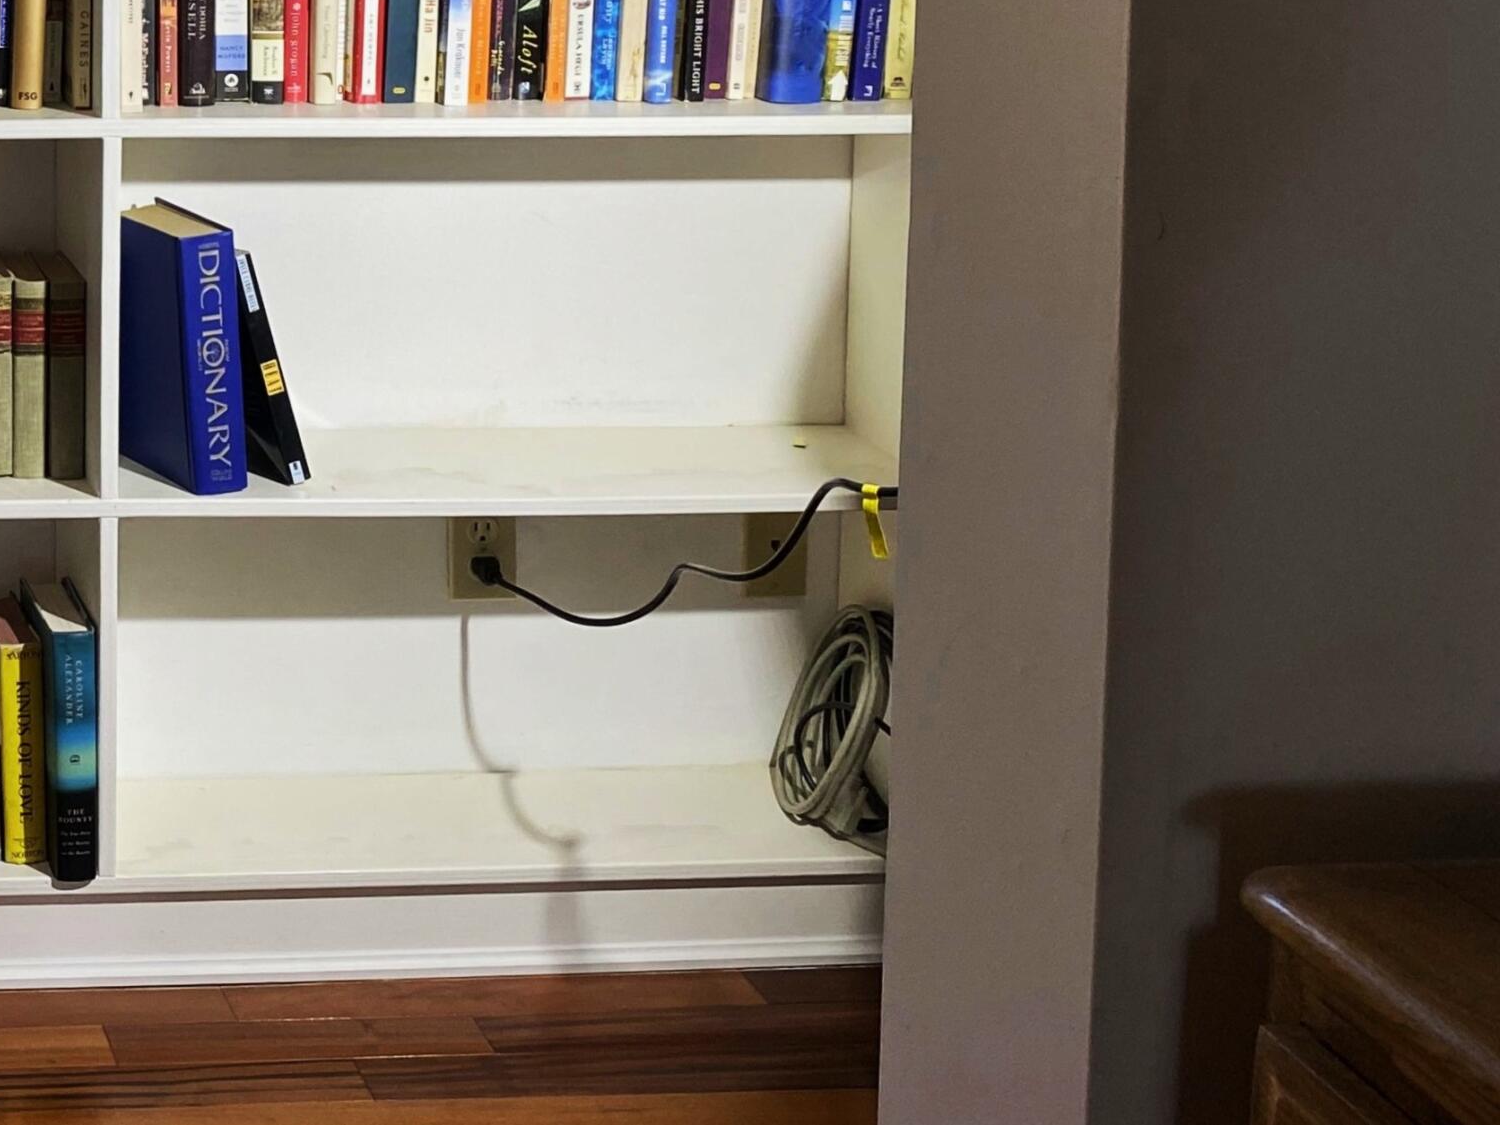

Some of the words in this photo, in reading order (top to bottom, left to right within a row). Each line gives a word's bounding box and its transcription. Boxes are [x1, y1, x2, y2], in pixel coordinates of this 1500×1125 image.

[289, 10, 302, 37] john
[423, 17, 436, 34] Jin
[425, 0, 436, 14] Ha
[79, 10, 89, 68] GAINES
[289, 39, 300, 76] grogan
[519, 26, 540, 75] Aloft
[693, 17, 704, 58] BRIGHT
[19, 92, 38, 101] FSG
[691, 61, 702, 94] LIGHT
[197, 249, 232, 468] DICTIONARY
[15, 680, 32, 737] KINDS
[64, 654, 74, 725] ALEXANDER
[75, 659, 84, 718] CAROLINE
[17, 742, 33, 768] OF
[18, 776, 34, 824] LOVE
